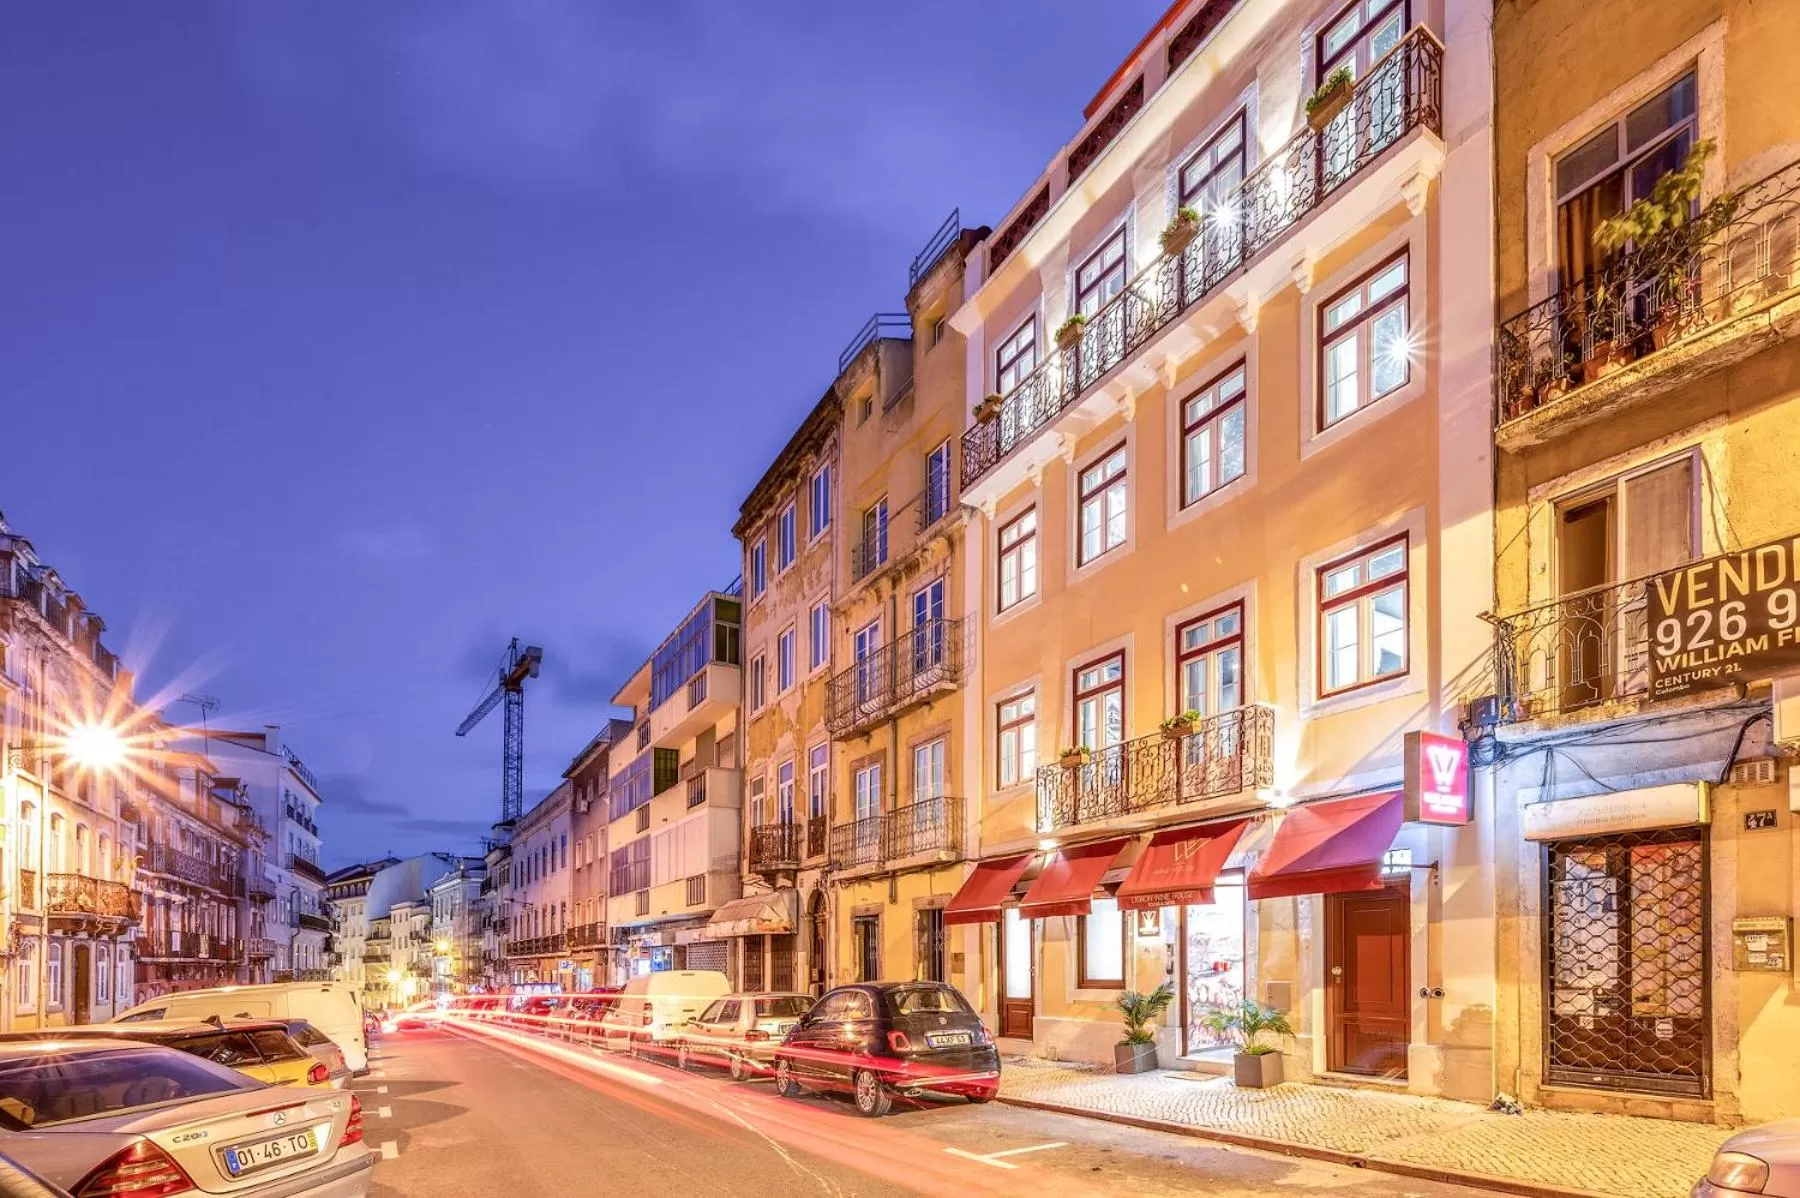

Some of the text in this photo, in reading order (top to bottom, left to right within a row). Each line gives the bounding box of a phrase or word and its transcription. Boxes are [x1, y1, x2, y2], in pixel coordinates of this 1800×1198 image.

[1655, 539, 1800, 616] VEND
[1656, 588, 1798, 656] 926 9
[1655, 666, 1721, 689] CENTURY
[1656, 634, 1769, 673] WILLIAM
